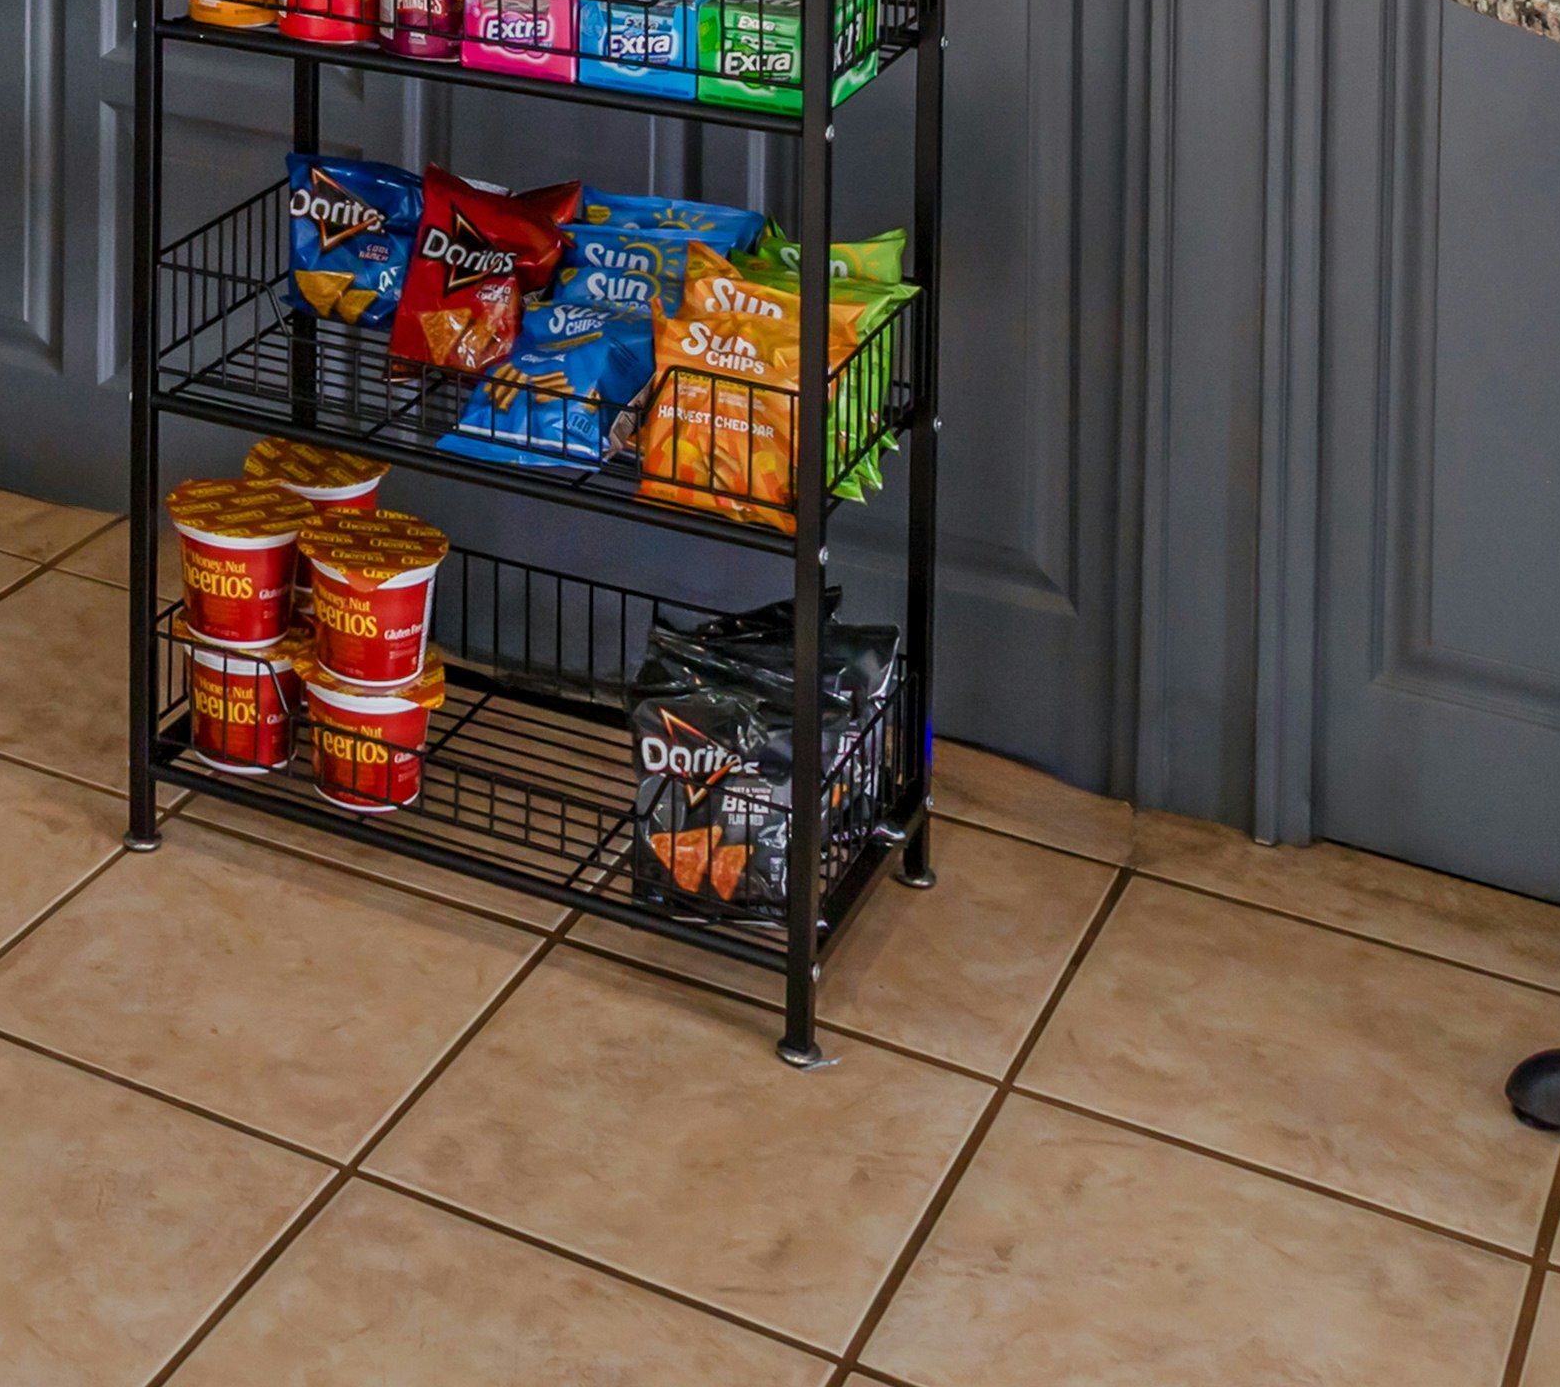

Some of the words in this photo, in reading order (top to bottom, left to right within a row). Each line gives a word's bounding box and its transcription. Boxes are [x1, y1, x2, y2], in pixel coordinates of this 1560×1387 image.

[485, 16, 548, 41] Extra
[609, 32, 672, 56] Extra
[723, 50, 792, 75] Extra
[289, 188, 386, 235] Doritos
[421, 227, 517, 275] Doritos
[584, 242, 649, 273] Sun
[586, 271, 648, 303] Sun
[704, 277, 783, 320] Sun
[681, 321, 758, 359] Sun
[705, 350, 765, 376] CHIPS
[657, 404, 712, 427] HARVEST
[225, 560, 247, 574] Nut
[349, 597, 371, 612] Nut
